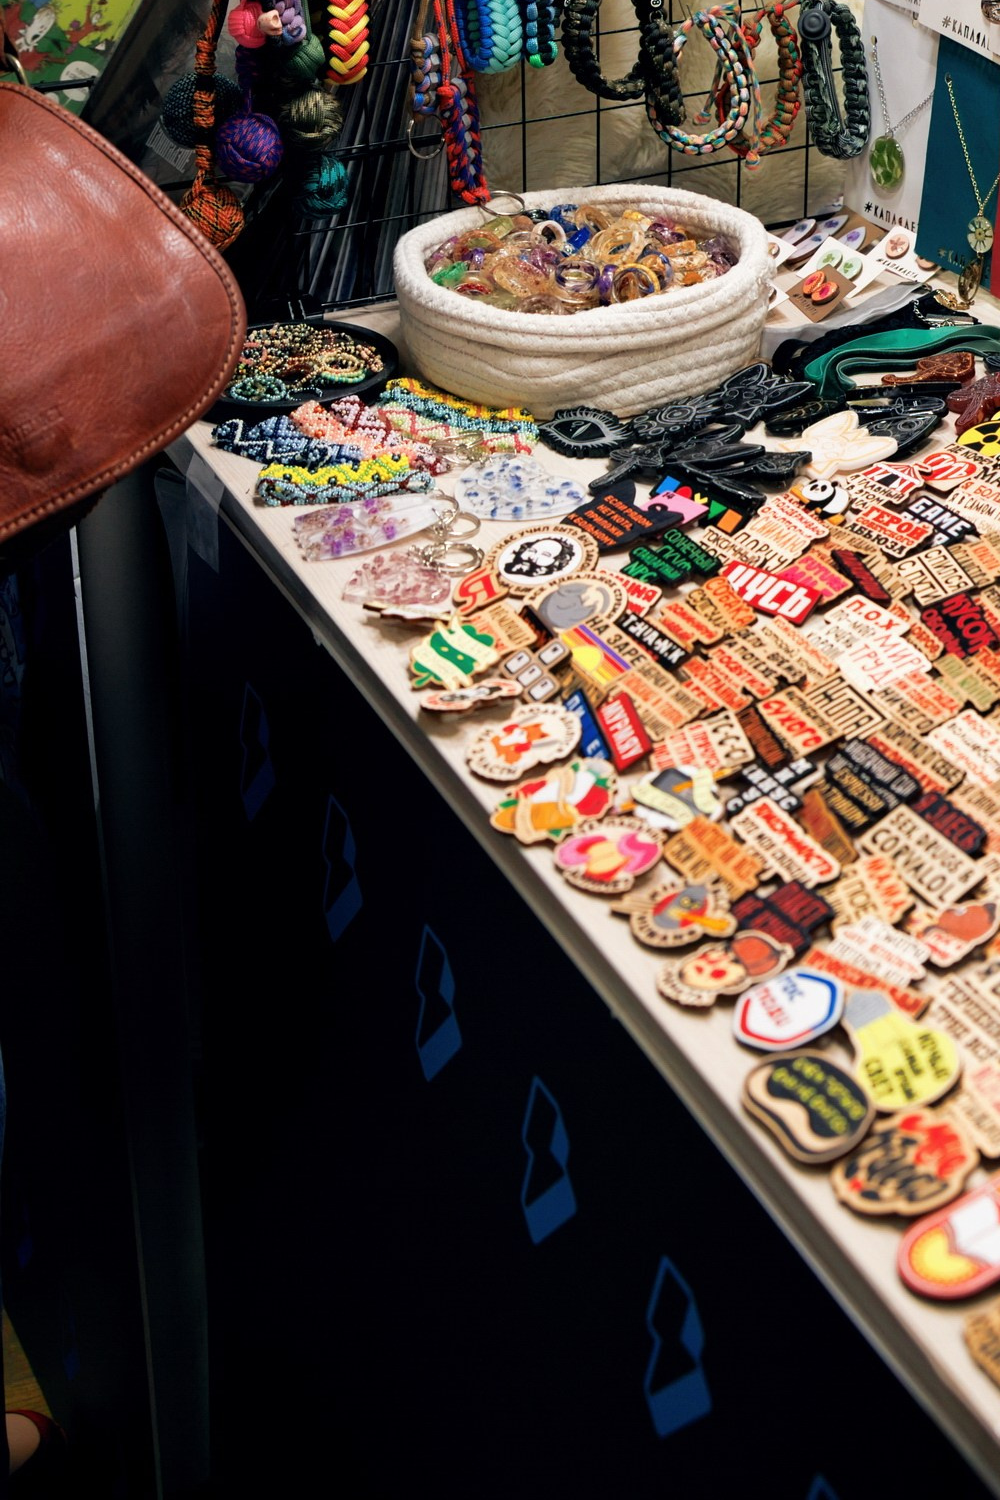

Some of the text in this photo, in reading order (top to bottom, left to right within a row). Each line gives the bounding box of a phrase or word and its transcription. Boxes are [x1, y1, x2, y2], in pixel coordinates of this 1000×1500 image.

[596, 502, 617, 518] НЕТ
[856, 488, 884, 506] ЭТОМ
[859, 478, 905, 502] ГЛАВНЫЙ
[583, 508, 624, 537] ПРИЛОЖИ
[603, 494, 652, 528] ЕСЛИ РЯДОМ
[862, 504, 929, 540] ГЕРОЙ
[908, 496, 971, 537] GAME
[572, 517, 616, 546] БОЛЬНОМУ
[663, 527, 716, 572] СОЛНЕЧНЫЙ
[846, 522, 907, 556] АБЬЮЗА
[623, 561, 657, 583] NPC
[797, 553, 847, 592] FUTURE
[898, 560, 943, 602] С ПУТИ
[925, 548, 968, 591] СПИЛСЯ
[704, 575, 756, 627] СОБАКА
[727, 562, 812, 619] ЦУСЬ
[585, 615, 647, 667] НА ЗАРЕ
[942, 592, 996, 653] КУСОК
[762, 696, 824, 747] СУХОГО
[876, 686, 933, 731] НИЧЕГО
[889, 811, 919, 838] SEX
[869, 826, 955, 902] CORVALOL
